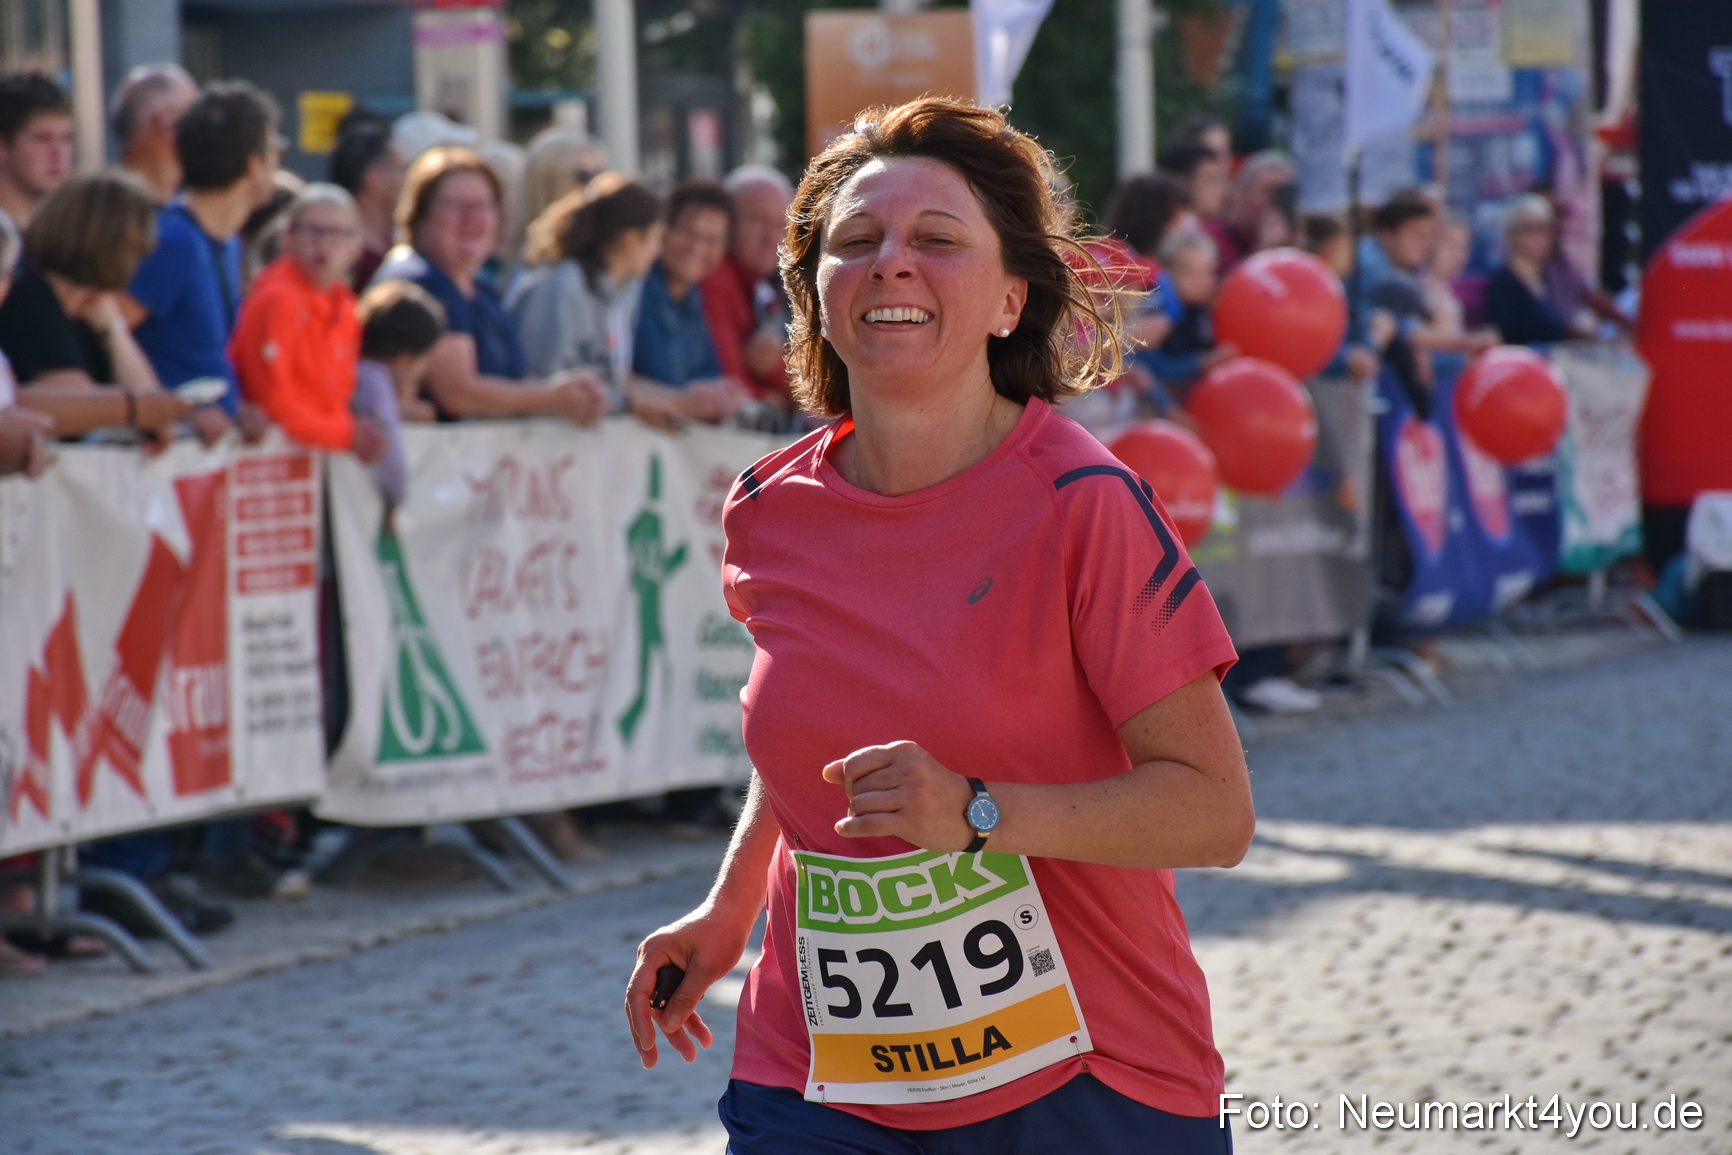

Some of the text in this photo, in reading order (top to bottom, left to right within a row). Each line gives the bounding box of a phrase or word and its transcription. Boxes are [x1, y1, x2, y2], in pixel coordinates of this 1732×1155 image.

[809, 851, 1000, 921] BOCK
[1019, 909, 1033, 925] S
[817, 919, 1025, 1019] 5219
[870, 1025, 1013, 1073] STILLA
